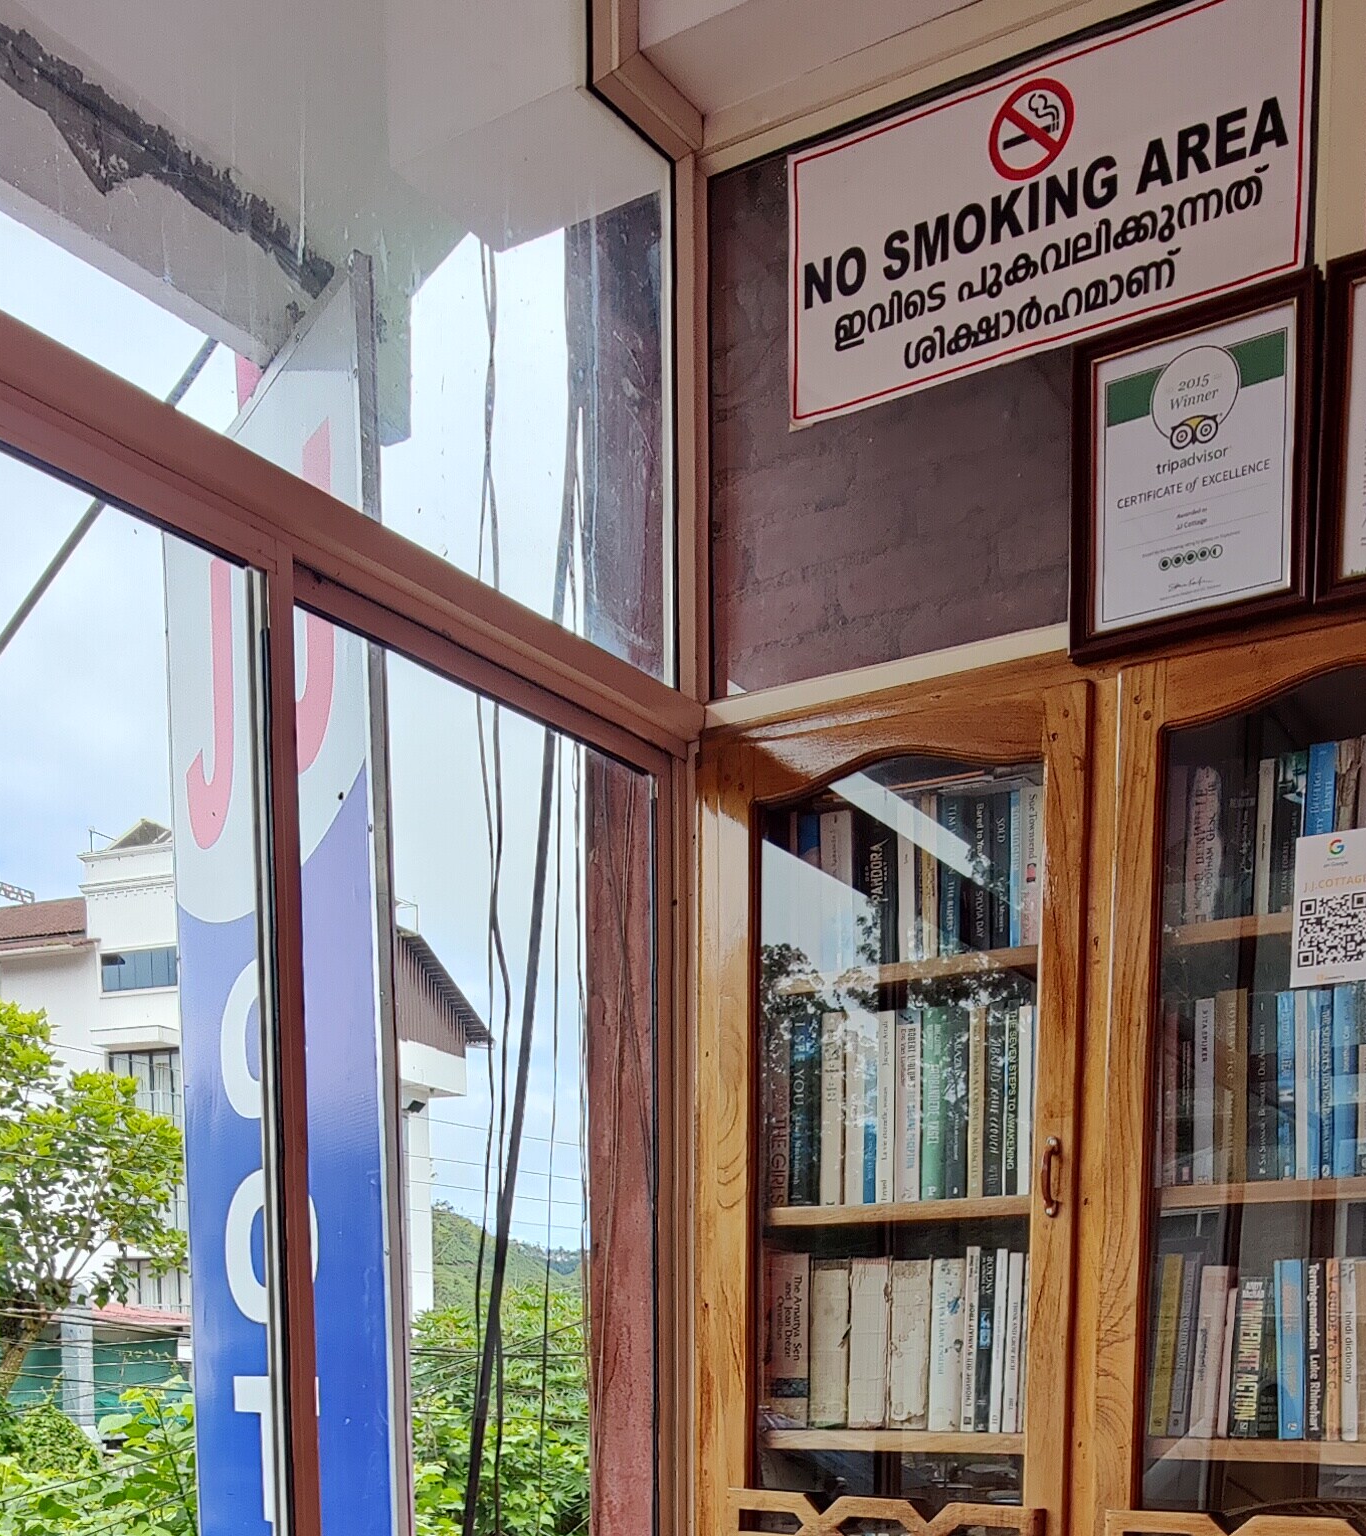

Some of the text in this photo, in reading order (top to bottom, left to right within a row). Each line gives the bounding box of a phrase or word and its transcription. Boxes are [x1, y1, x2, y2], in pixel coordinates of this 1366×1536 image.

[803, 96, 1289, 310] NO SMOKING AREA
[835, 281, 947, 352] ഇവിടെ
[1170, 388, 1219, 410] Winner
[1177, 374, 1211, 392] 2015
[1117, 458, 1271, 510] CERTIFICATE of EXCELLENCE
[1155, 446, 1229, 476] tripadvisor
[975, 802, 985, 856] Bared to You
[995, 816, 1007, 842] SOLD
[1027, 794, 1039, 860] Sue Townsend
[865, 838, 889, 904] PANDORA
[946, 900, 955, 932] RIDERS
[975, 890, 985, 938] SYLVIA DAY
[793, 1068, 805, 1106] YOU
[1005, 1010, 1017, 1170] THE SEVEN STEPS TO AWAKENING
[1321, 1010, 1331, 1115] THE SERPENT'S REVENGE
[771, 1120, 787, 1206] THE GIRLS
[783, 1281, 793, 1328] and Jean
[985, 1255, 995, 1296] ANGKOR
[775, 1294, 785, 1341] Omnibus
[791, 1275, 803, 1362] The Amartya Sen
[1327, 1290, 1337, 1352] GUIDE To
[937, 1344, 946, 1376] ENGLISH
[965, 1302, 975, 1406] L'HOMME QUI S'AIMAIT TROP
[1234, 1300, 1264, 1421] IMMEDIATE ACTION
[1307, 1262, 1321, 1432] Terningemanden Luke Rhinehart
[1343, 1310, 1355, 1385] hindi dictionary
